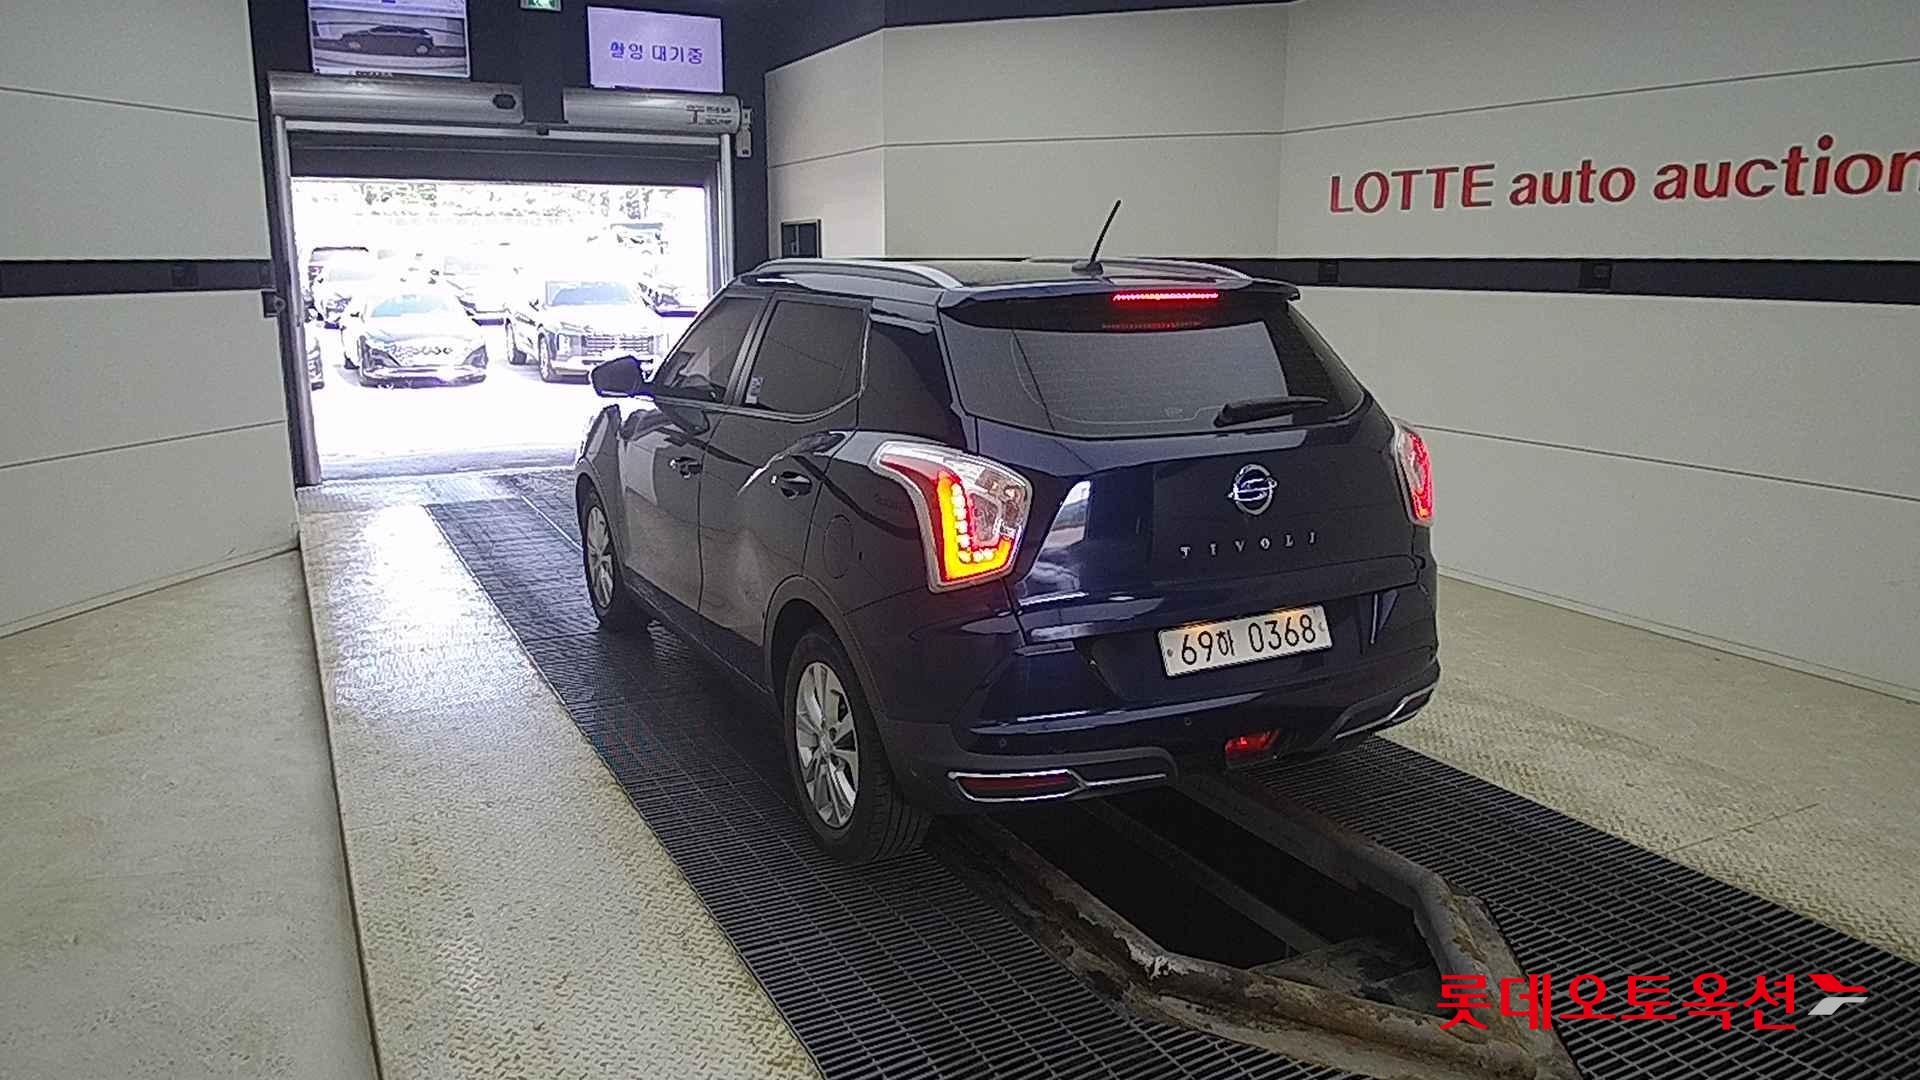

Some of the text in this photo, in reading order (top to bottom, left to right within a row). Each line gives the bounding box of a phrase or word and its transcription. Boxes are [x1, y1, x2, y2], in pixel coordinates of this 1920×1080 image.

[651, 44, 703, 65] 대기중
[1329, 164, 1495, 214] LOTTE
[1509, 159, 1635, 206] auto
[1180, 531, 1317, 559] TIVOLI
[1181, 614, 1316, 666] 69하 0368
